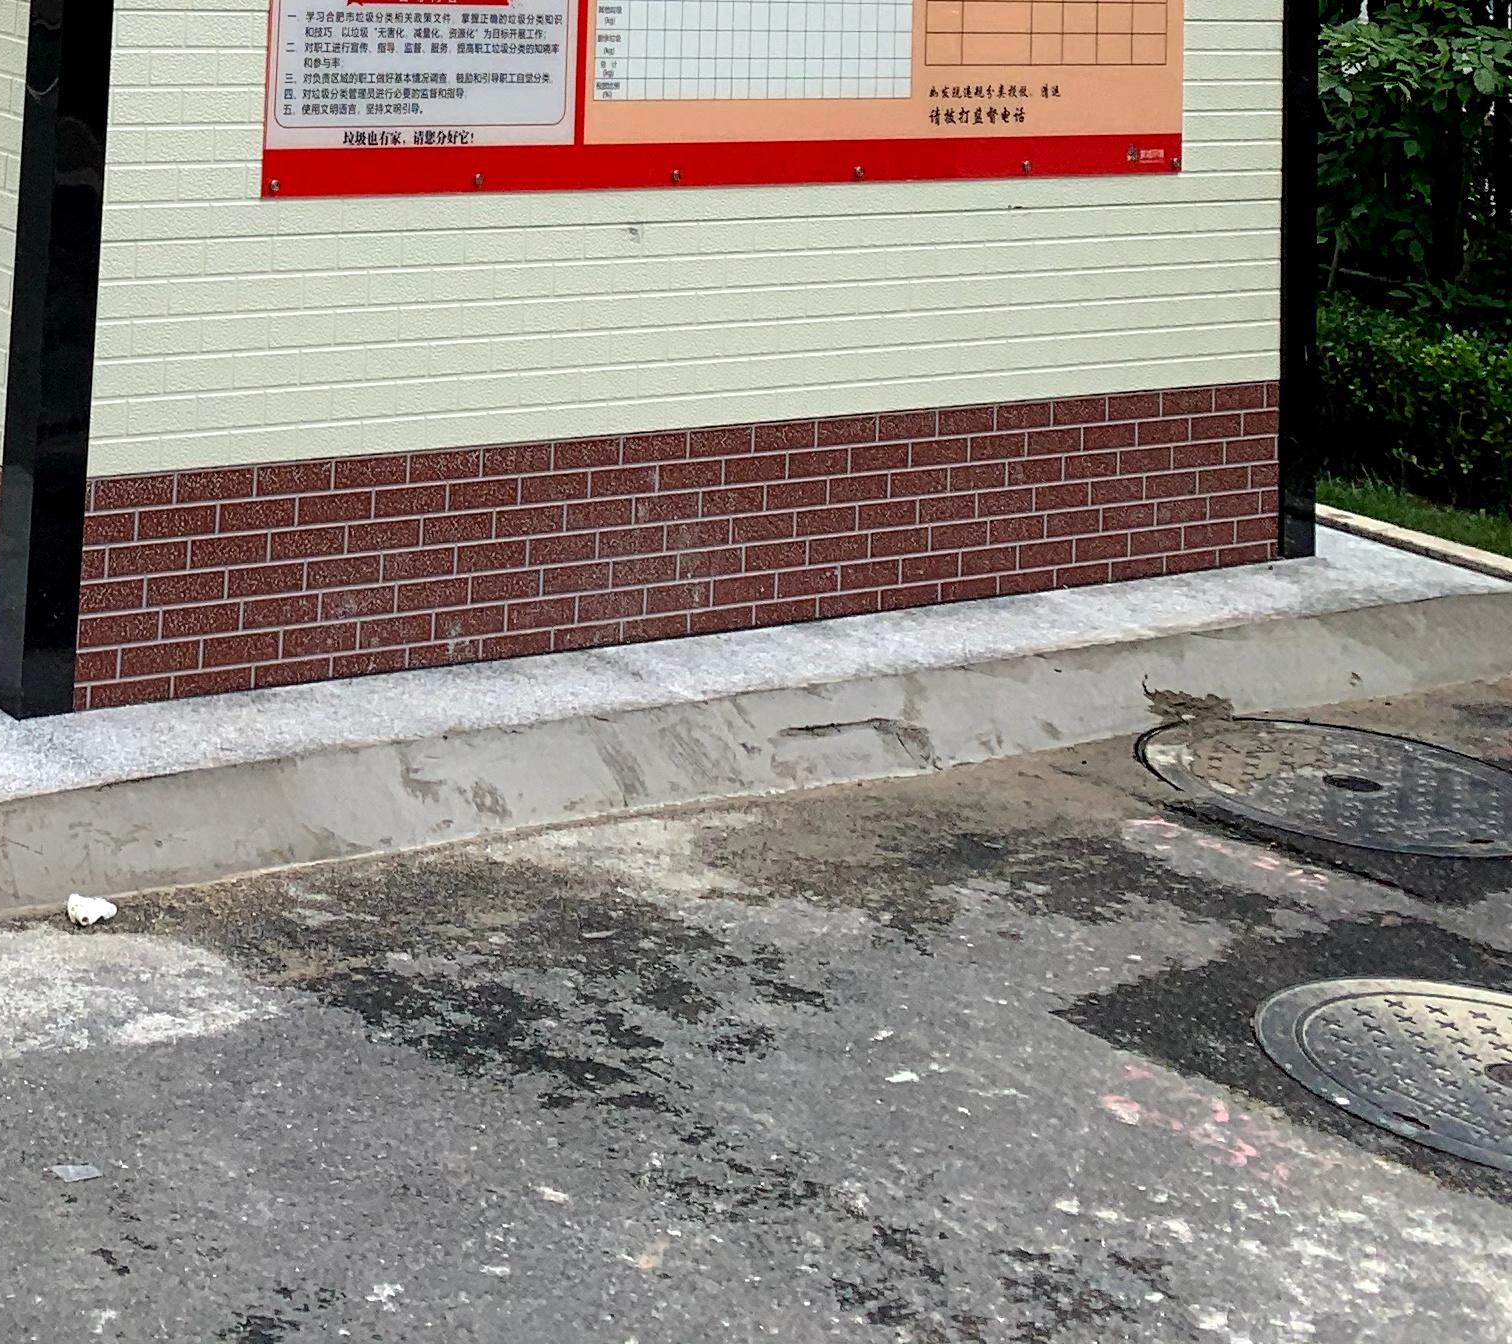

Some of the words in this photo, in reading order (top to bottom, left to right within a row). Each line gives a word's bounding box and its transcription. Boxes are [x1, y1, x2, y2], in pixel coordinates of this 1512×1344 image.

[929, 107, 1026, 126] 请拨打监督电话
